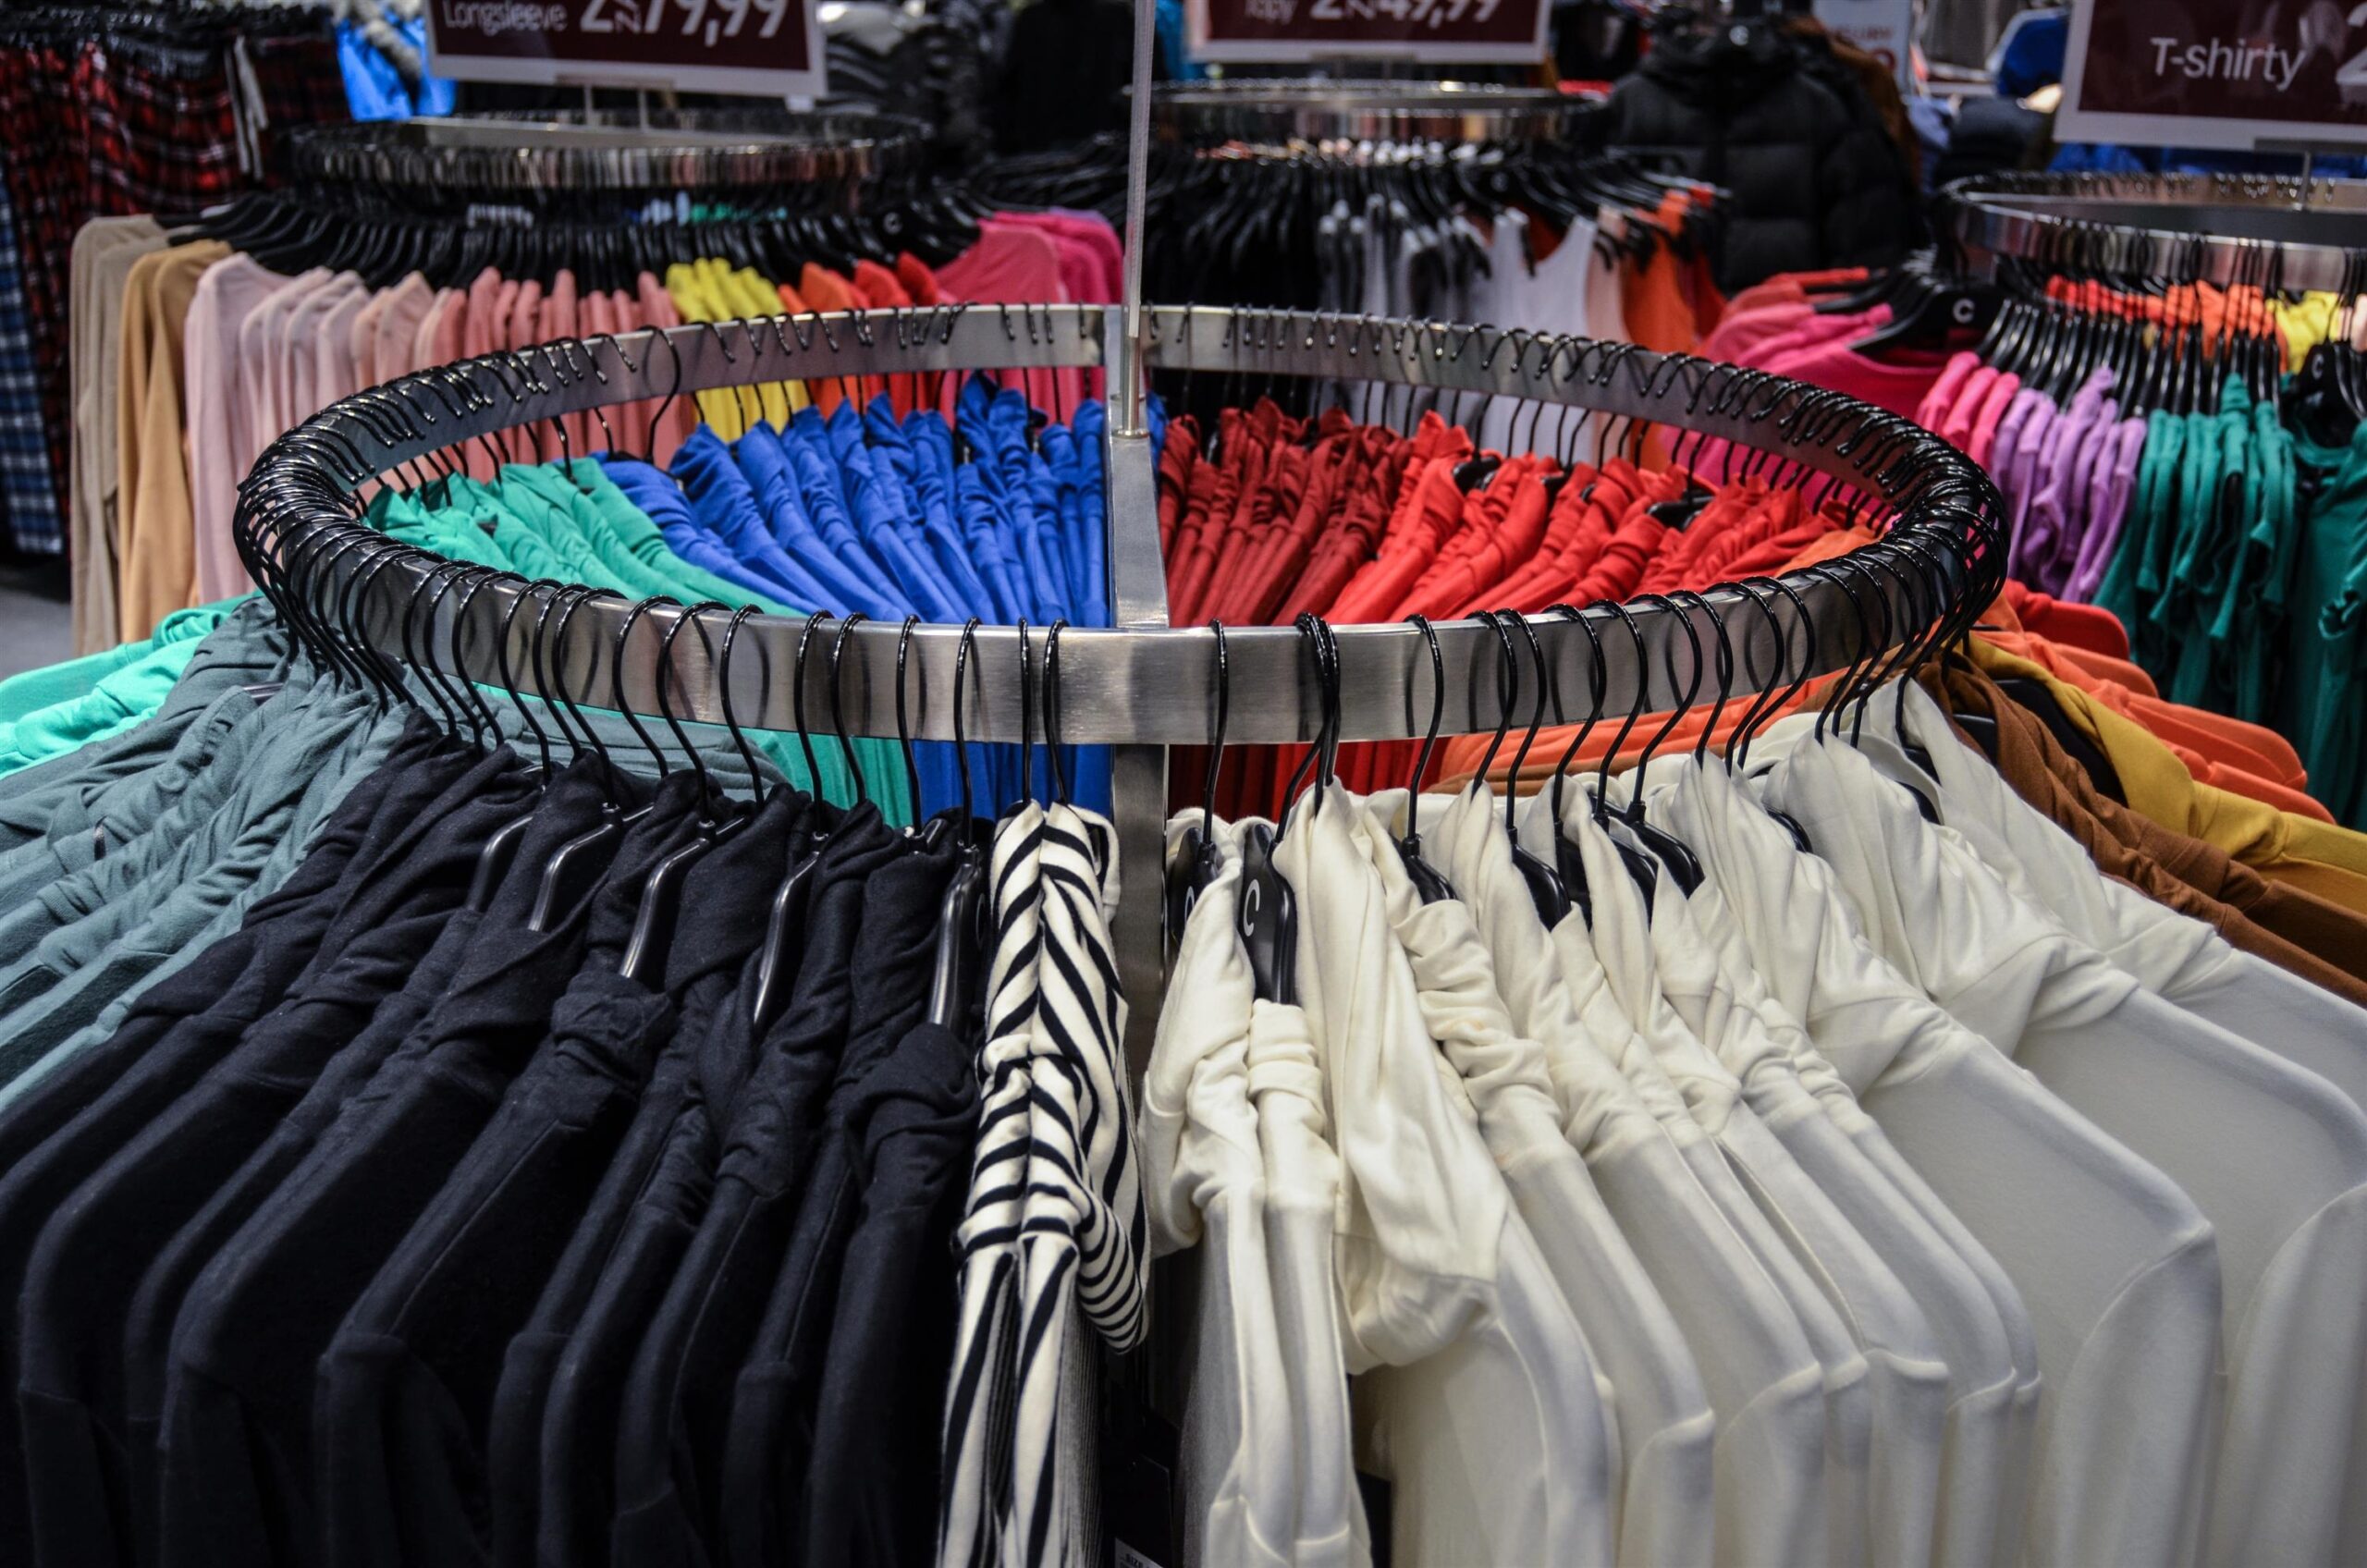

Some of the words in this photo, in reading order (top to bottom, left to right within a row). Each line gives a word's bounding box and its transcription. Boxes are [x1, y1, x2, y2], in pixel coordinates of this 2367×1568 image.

[2150, 37, 2308, 91] T-shirty
[1953, 298, 1975, 324] C
[1244, 879, 1260, 937] C
